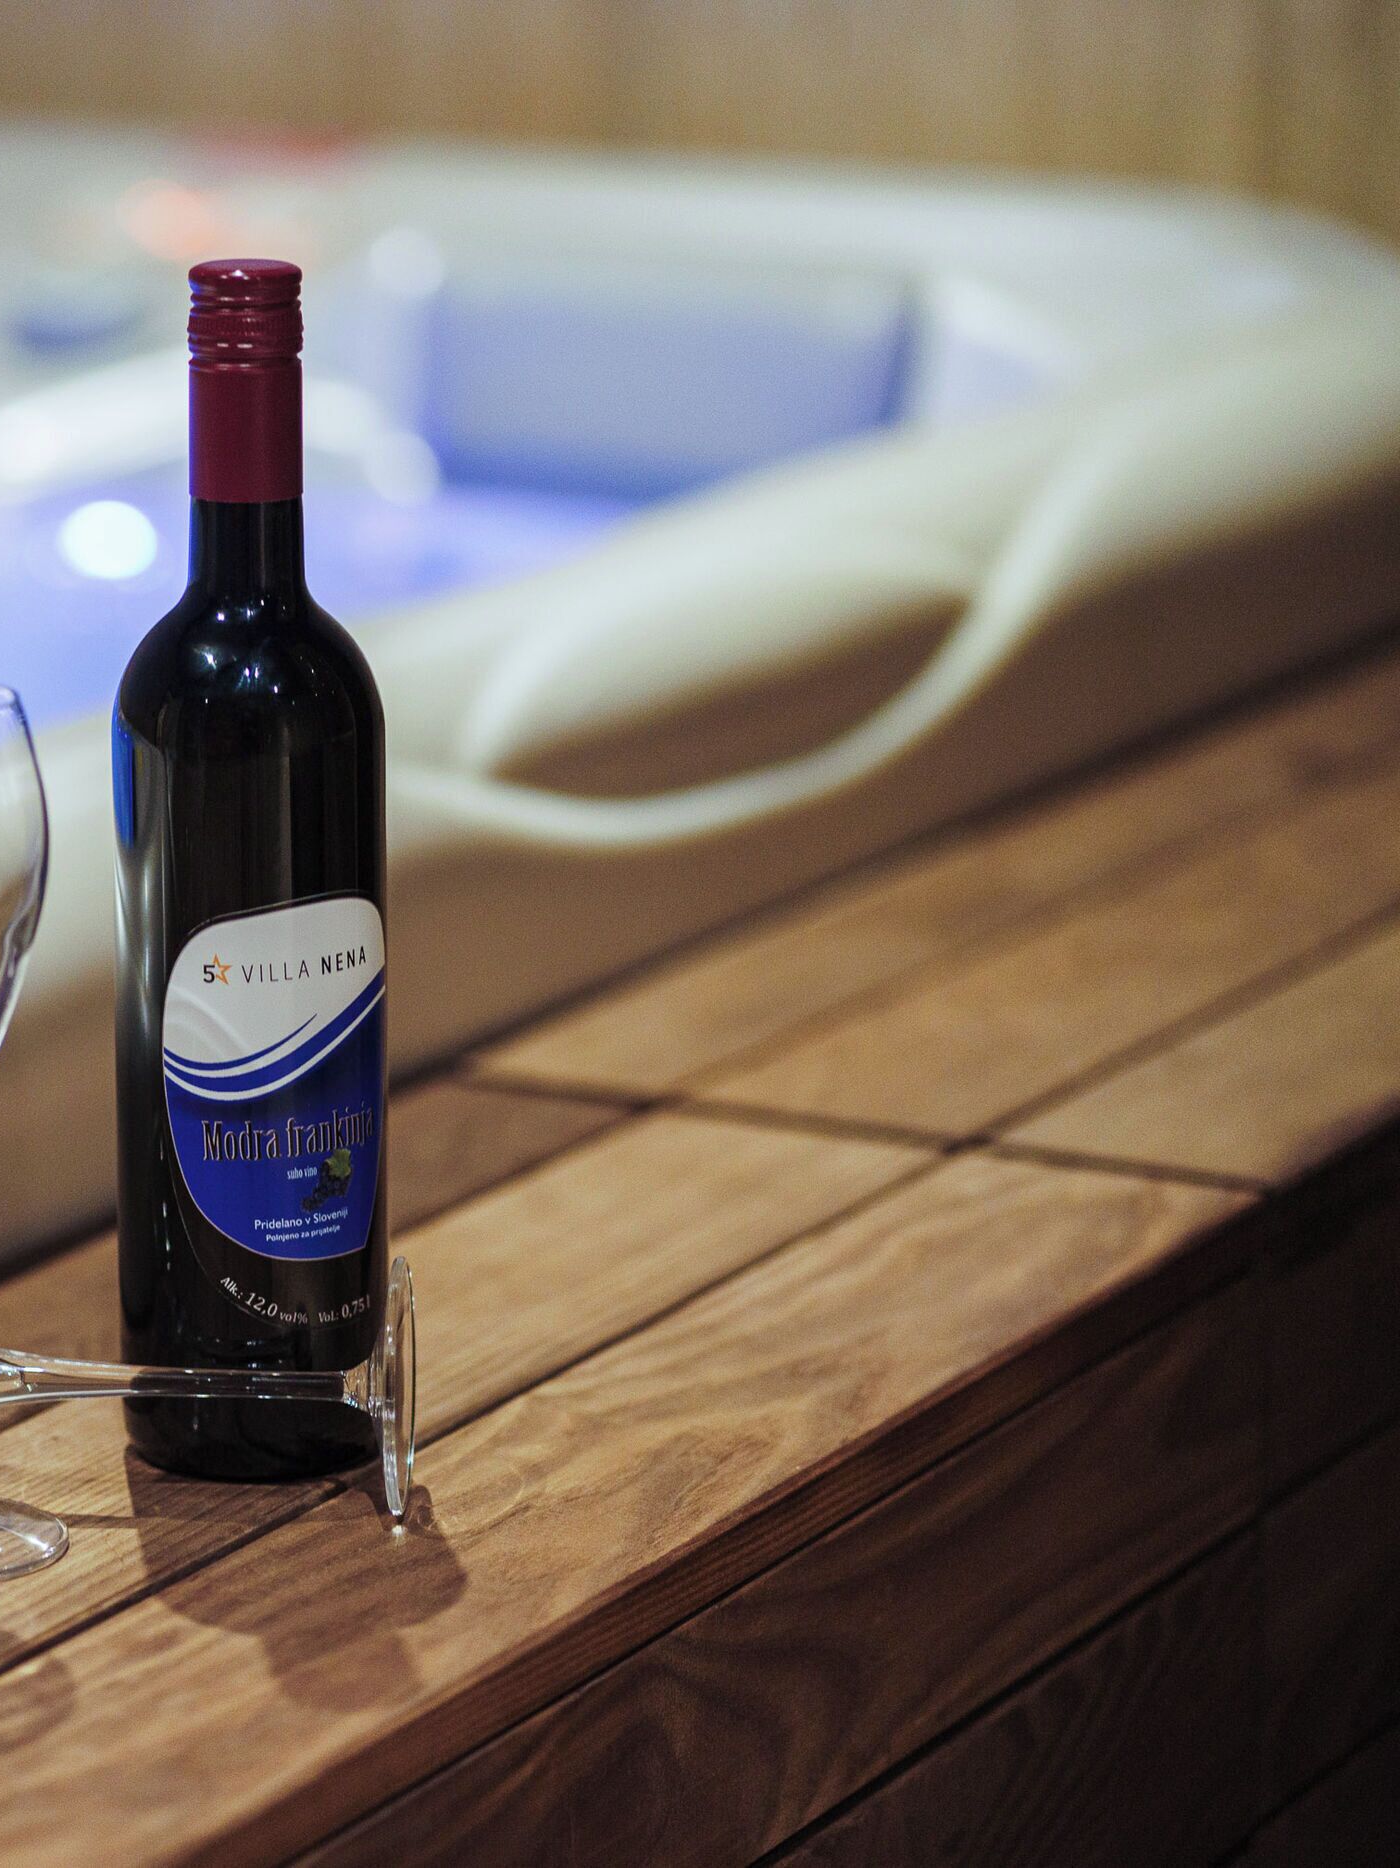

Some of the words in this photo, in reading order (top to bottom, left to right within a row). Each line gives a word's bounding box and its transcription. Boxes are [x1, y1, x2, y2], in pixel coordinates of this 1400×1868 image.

[202, 963, 216, 983] 5
[241, 960, 310, 984] VILLA
[320, 945, 367, 976] NENA
[201, 1120, 282, 1161] Modra
[285, 1101, 374, 1158] frankinja
[287, 1166, 303, 1180] suho
[304, 1165, 318, 1179] vino
[254, 1218, 303, 1230] Pridelano
[305, 1217, 311, 1225] v
[313, 1206, 349, 1224] Sloveniji
[265, 1232, 300, 1242] Polnjeno
[311, 1224, 341, 1237] prijatelje
[220, 1276, 243, 1299] Alk.:
[245, 1292, 278, 1317] 12,0
[341, 1298, 365, 1319] 0,75
